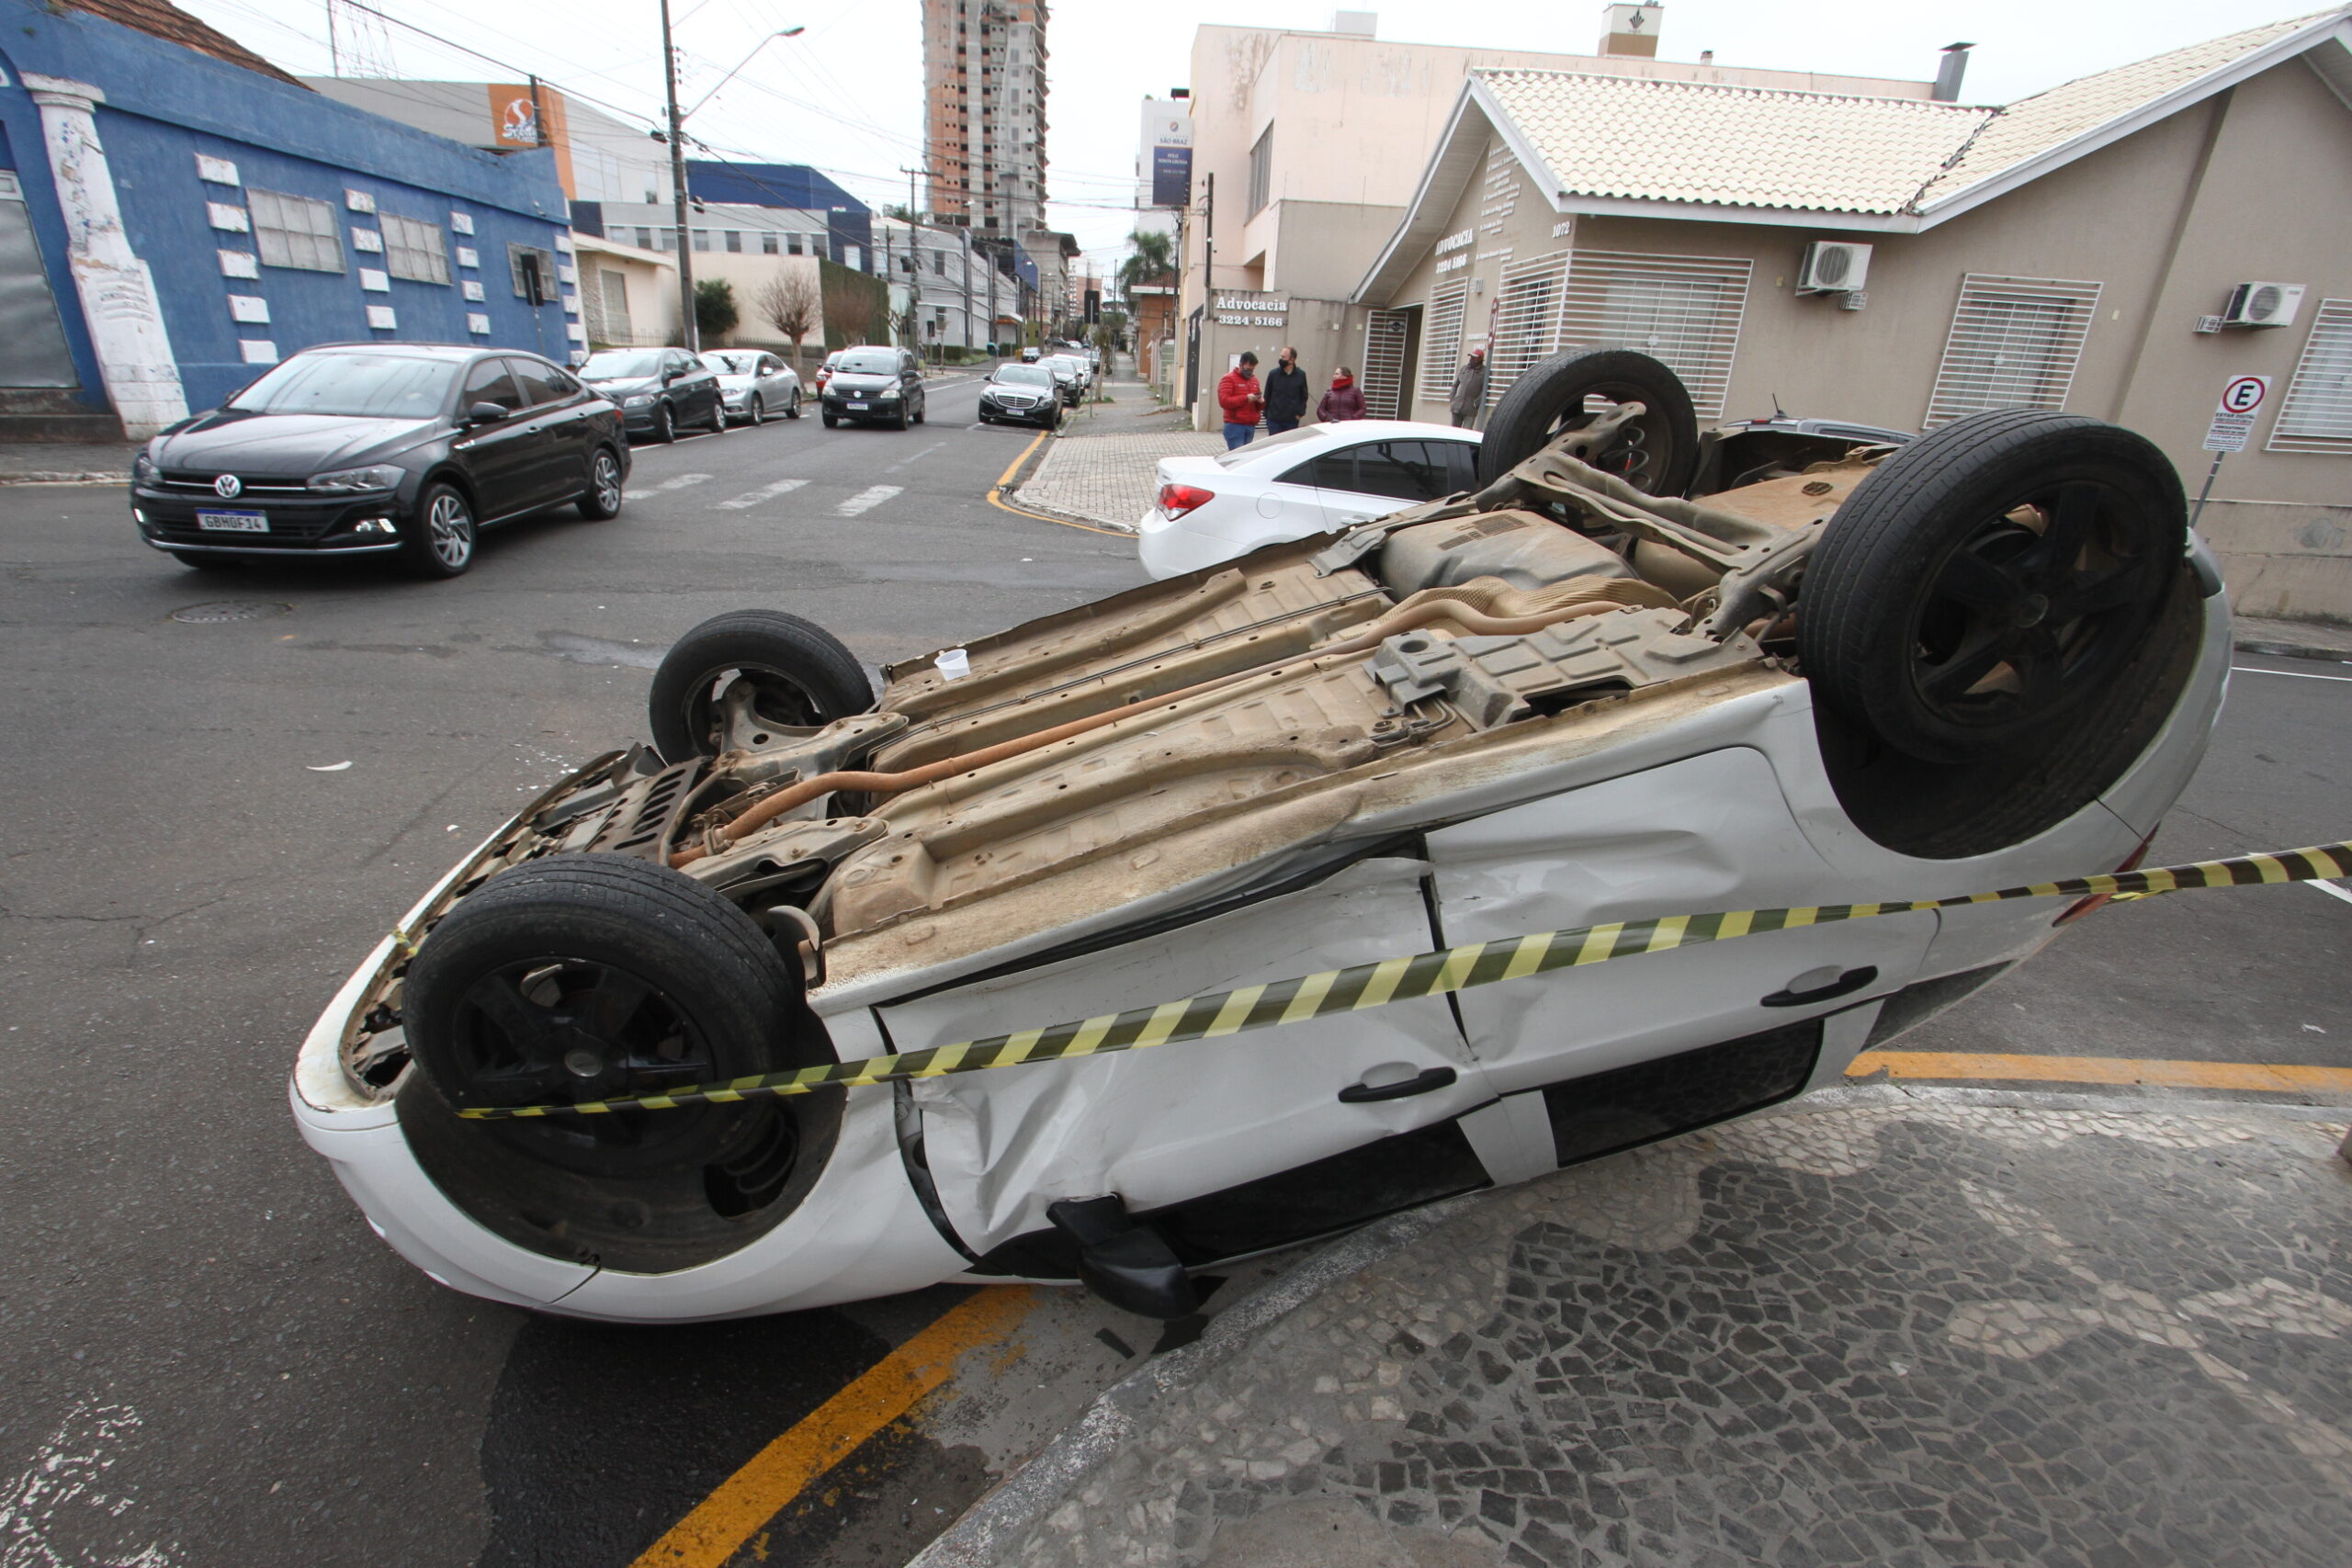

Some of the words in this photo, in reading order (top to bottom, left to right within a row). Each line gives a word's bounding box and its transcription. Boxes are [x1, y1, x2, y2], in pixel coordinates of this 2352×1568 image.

[1552, 220, 1571, 239] 1072
[1435, 228, 1473, 256] ADVOCACIA
[1216, 296, 1287, 311] Advocacia
[1218, 315, 1250, 325] 3224
[1254, 316, 1283, 327] 5166
[2233, 385, 2256, 406] E
